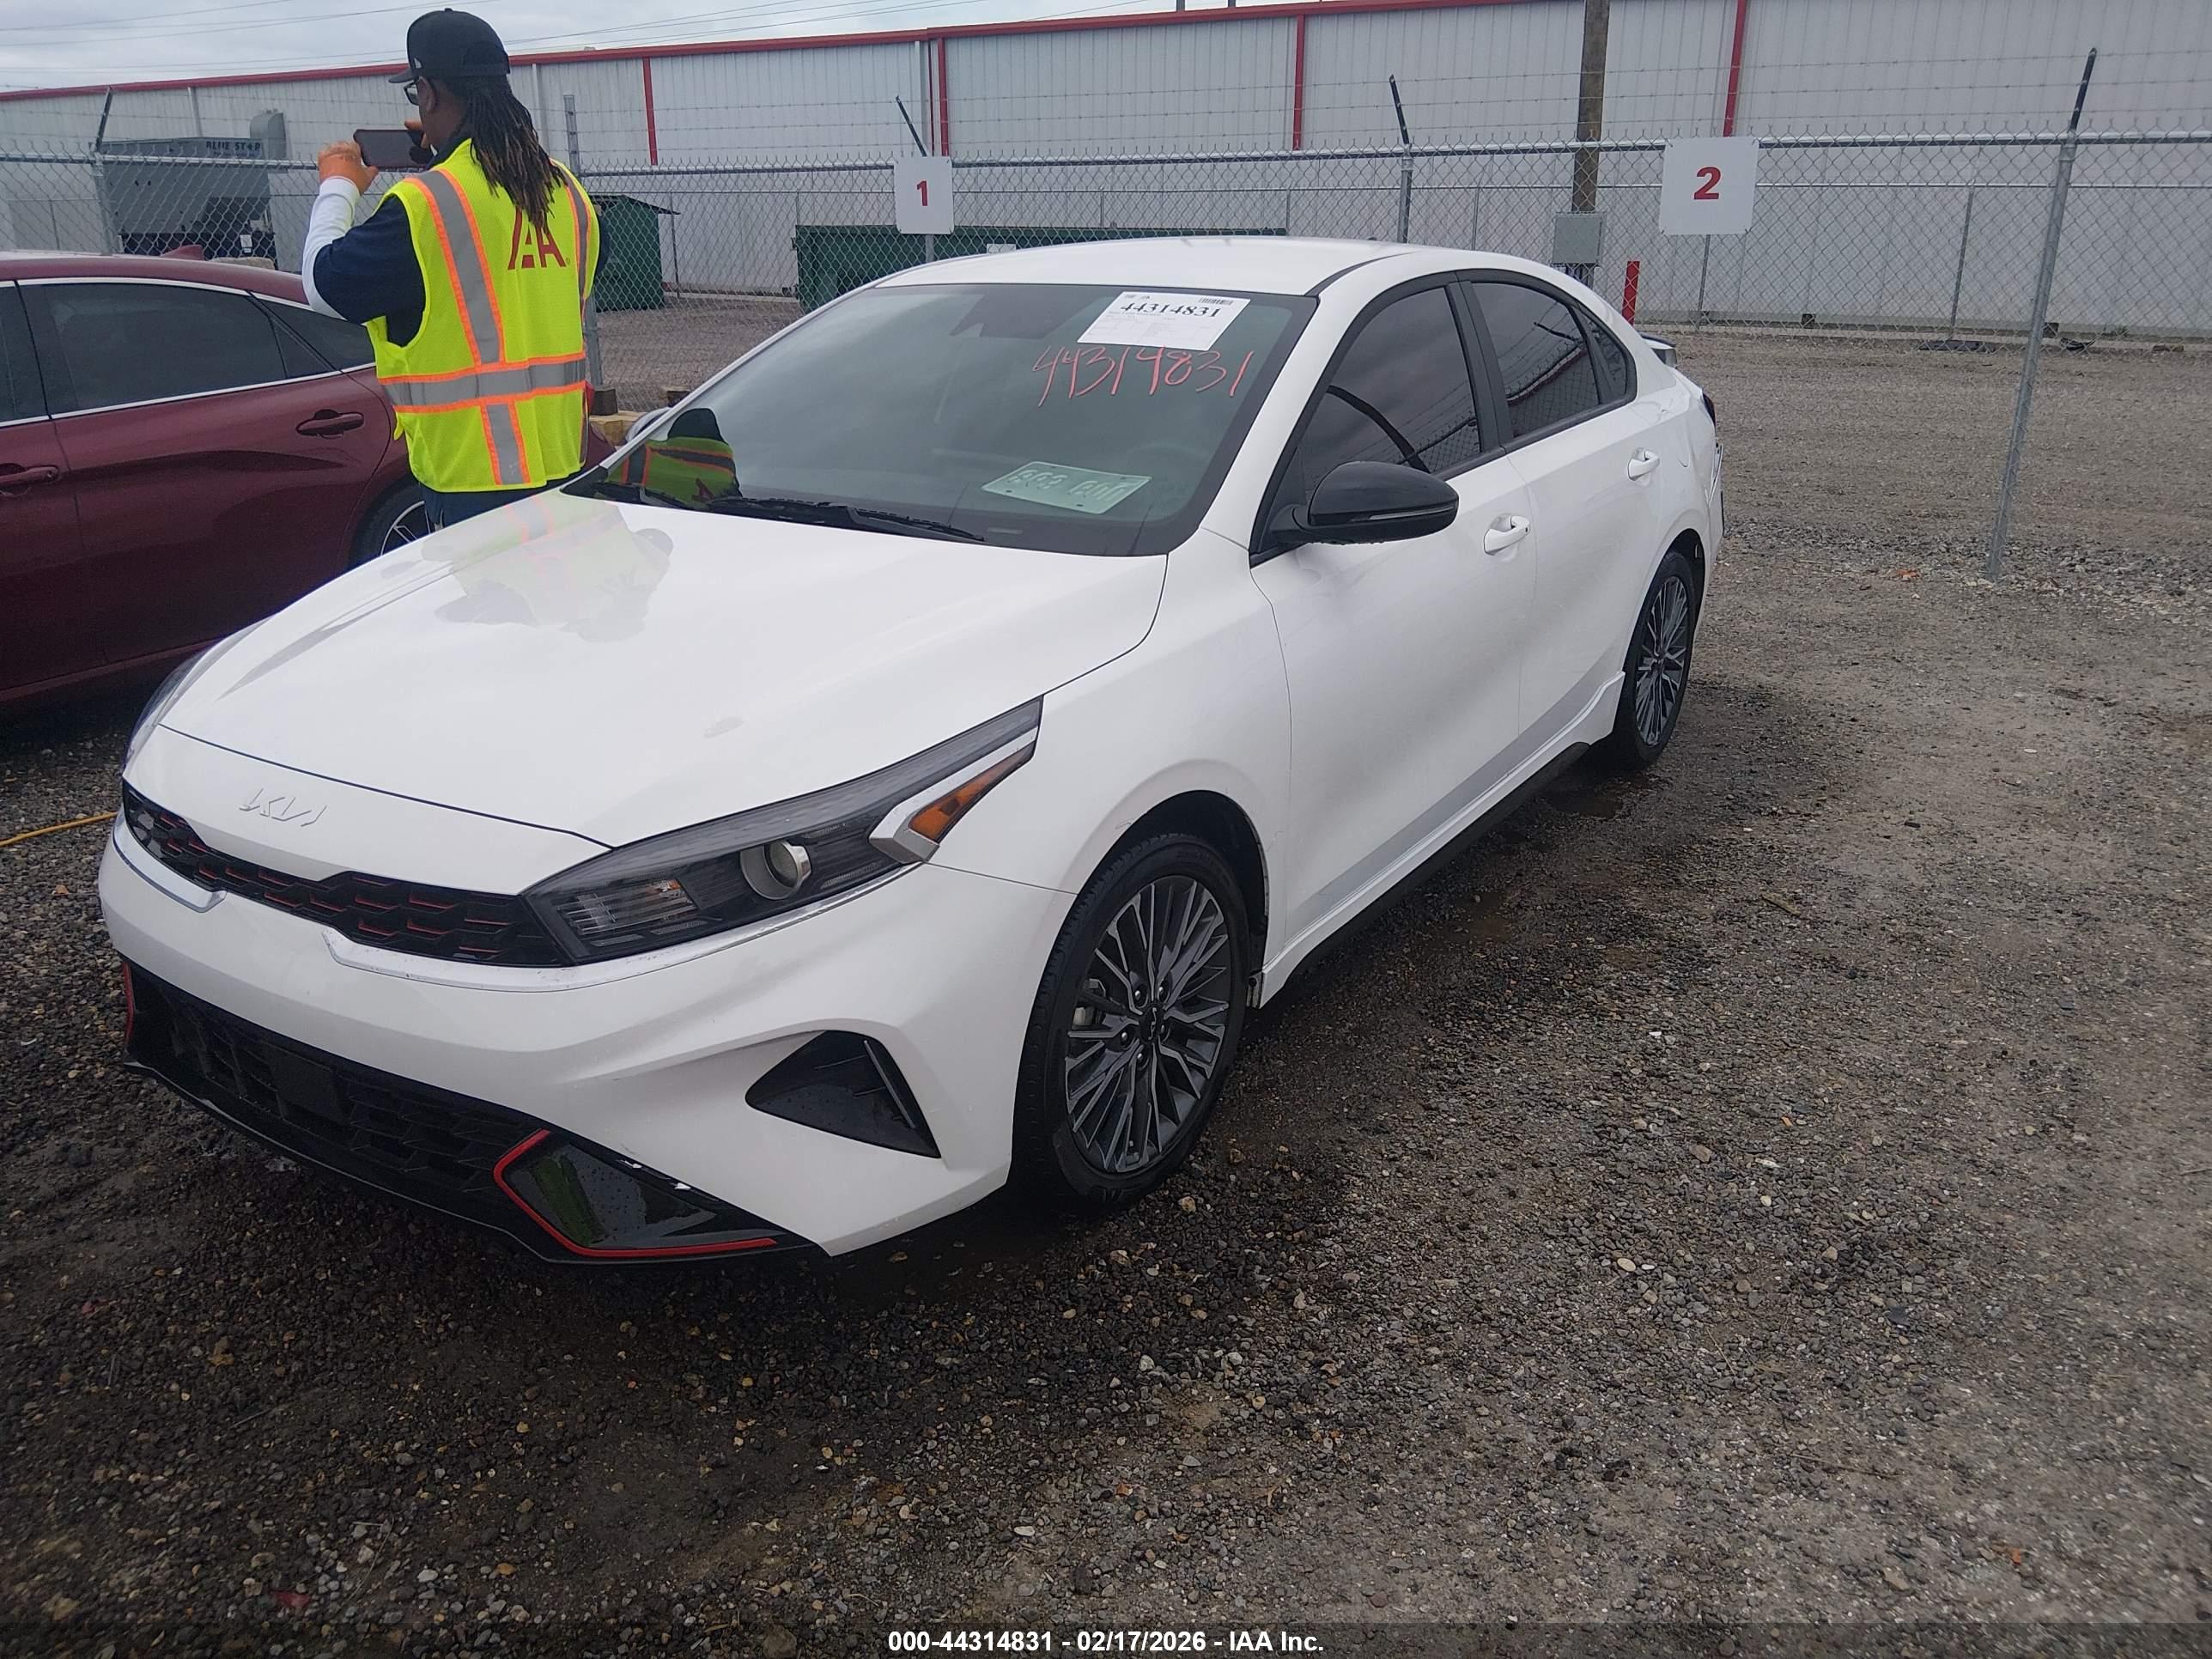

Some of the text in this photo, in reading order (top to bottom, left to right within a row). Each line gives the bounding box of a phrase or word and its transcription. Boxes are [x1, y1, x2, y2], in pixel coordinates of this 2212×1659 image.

[916, 179, 928, 207] 1
[1693, 166, 1722, 200] 2
[1120, 302, 1222, 318] 44314831
[1031, 344, 1255, 408] 44314831
[239, 787, 328, 829] KIA
